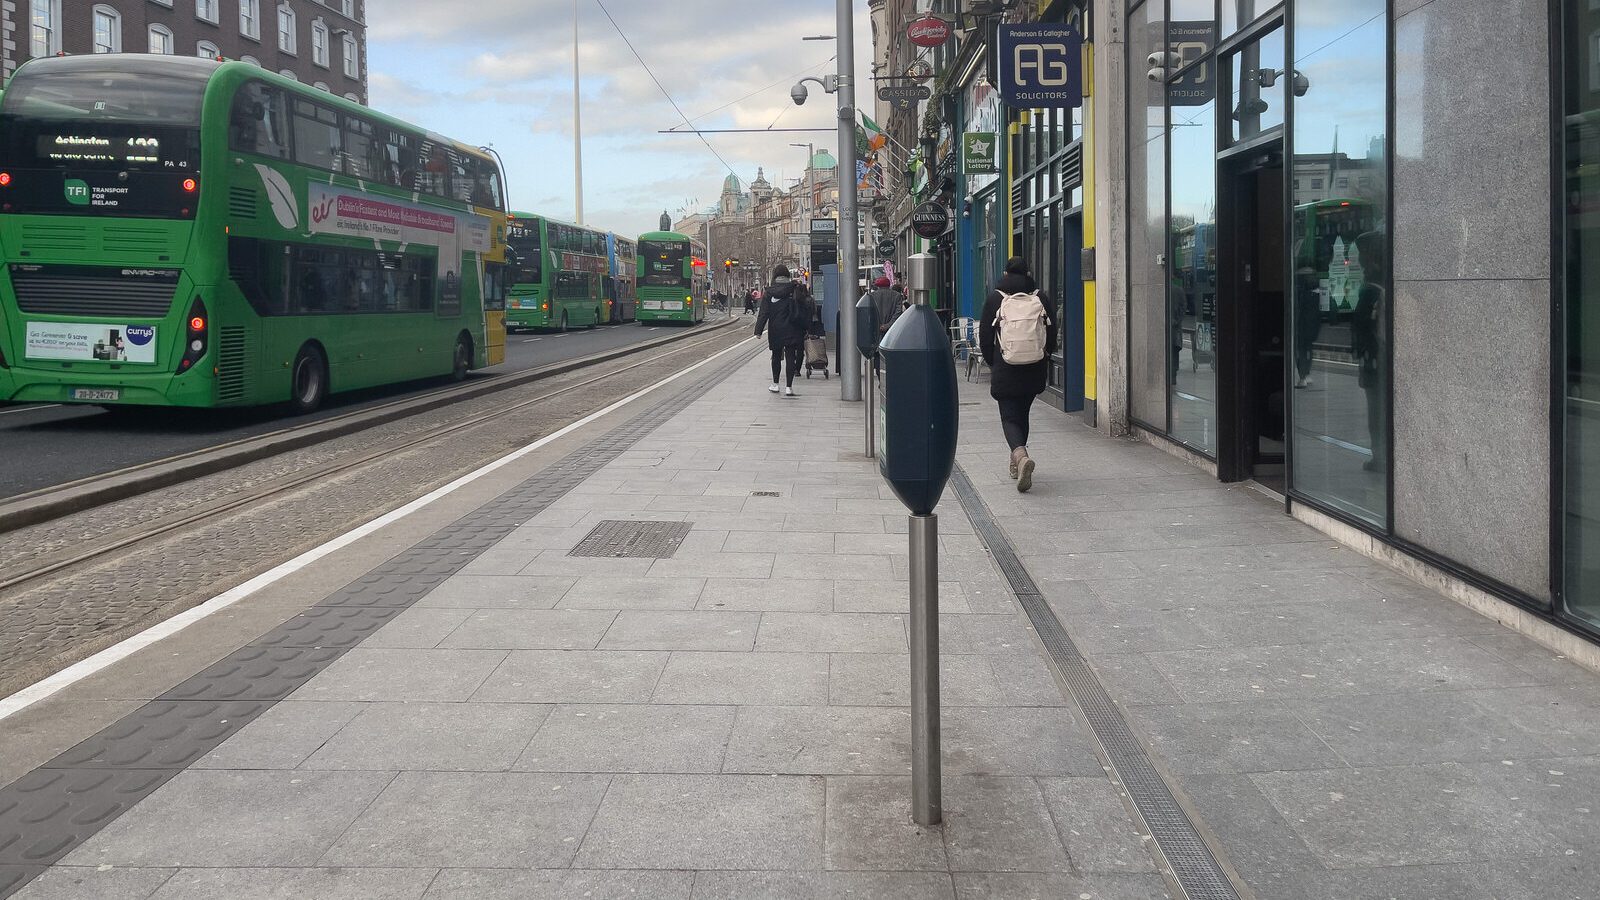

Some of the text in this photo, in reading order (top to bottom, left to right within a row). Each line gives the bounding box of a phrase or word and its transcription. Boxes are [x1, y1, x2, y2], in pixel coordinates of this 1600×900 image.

[1014, 43, 1067, 86] AG
[880, 89, 929, 98] CASSIDY'S
[1015, 92, 1067, 100] SOLICITORS
[900, 99, 909, 108] 27
[67, 186, 87, 196] TFI
[312, 193, 334, 224] eir
[913, 213, 946, 222] GUINNESS
[128, 327, 153, 338] currys
